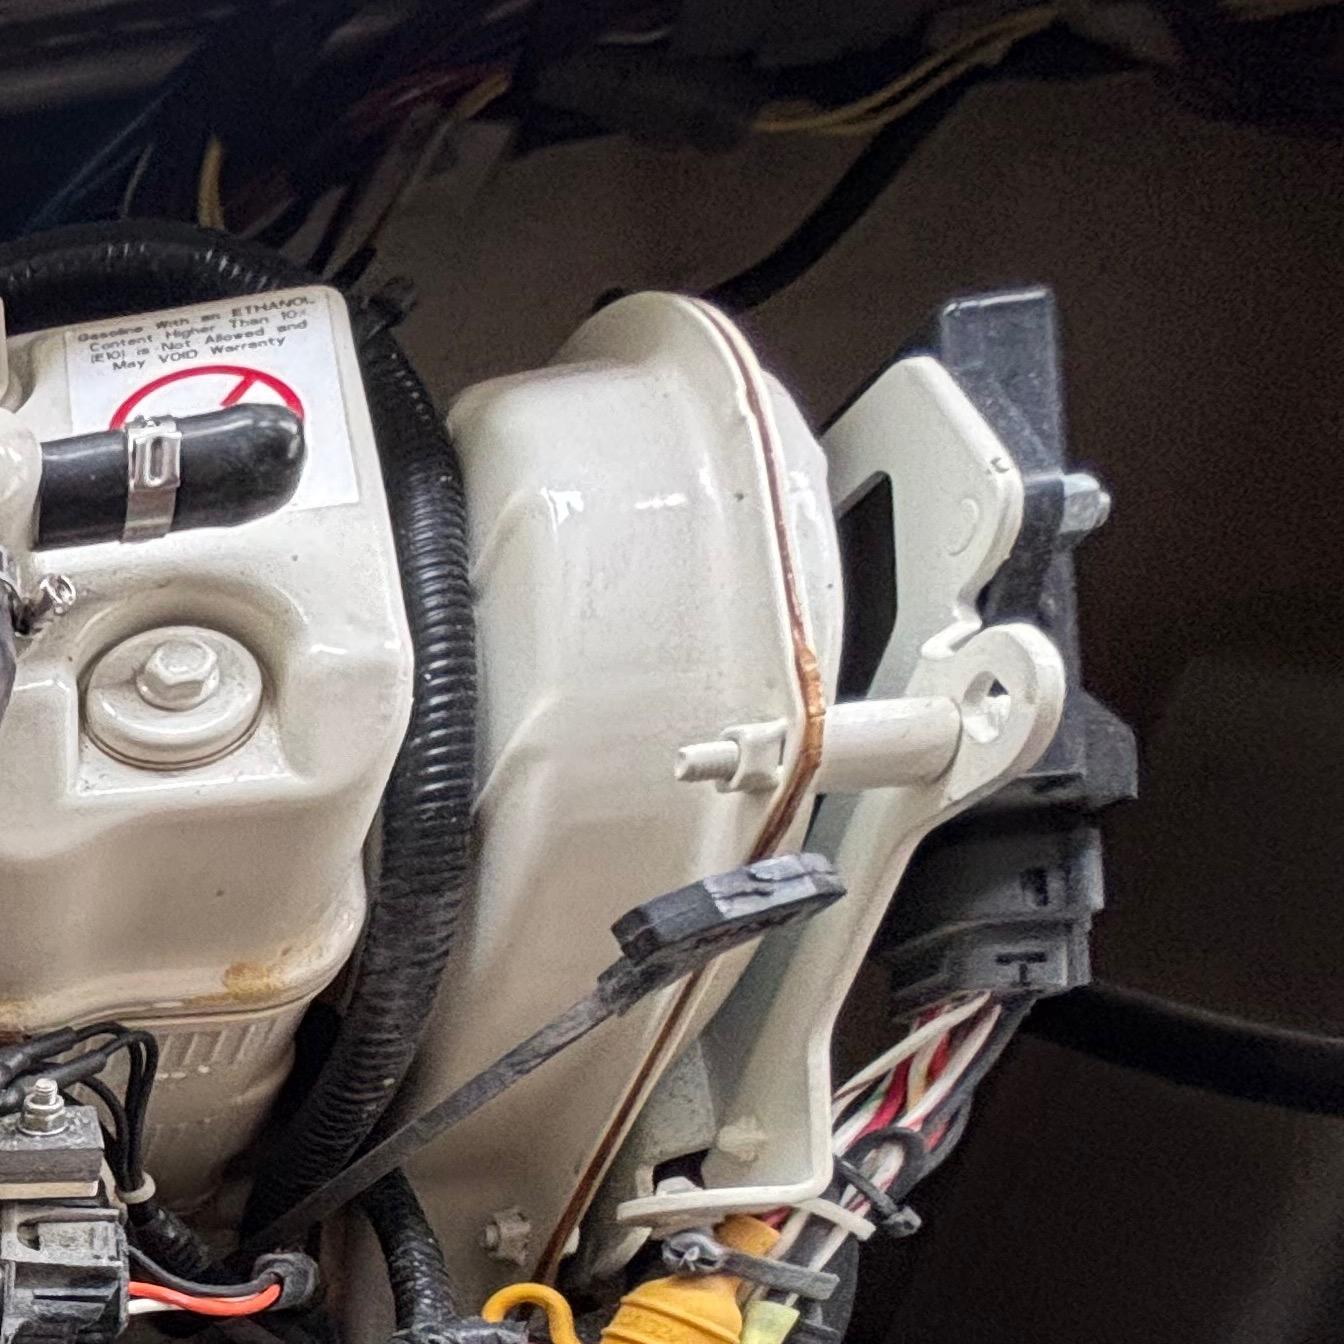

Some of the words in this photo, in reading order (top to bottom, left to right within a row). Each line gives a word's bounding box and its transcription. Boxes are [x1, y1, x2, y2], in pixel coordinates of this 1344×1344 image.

[231, 296, 315, 317] ETHANOL
[89, 334, 153, 352] Content
[164, 323, 216, 341] Higher
[228, 315, 269, 330] Than
[161, 340, 191, 352] Not
[204, 327, 265, 345] Allowed
[276, 319, 307, 333] and
[112, 359, 147, 371] May
[158, 349, 198, 363] VOID
[210, 335, 286, 355] Warranty
